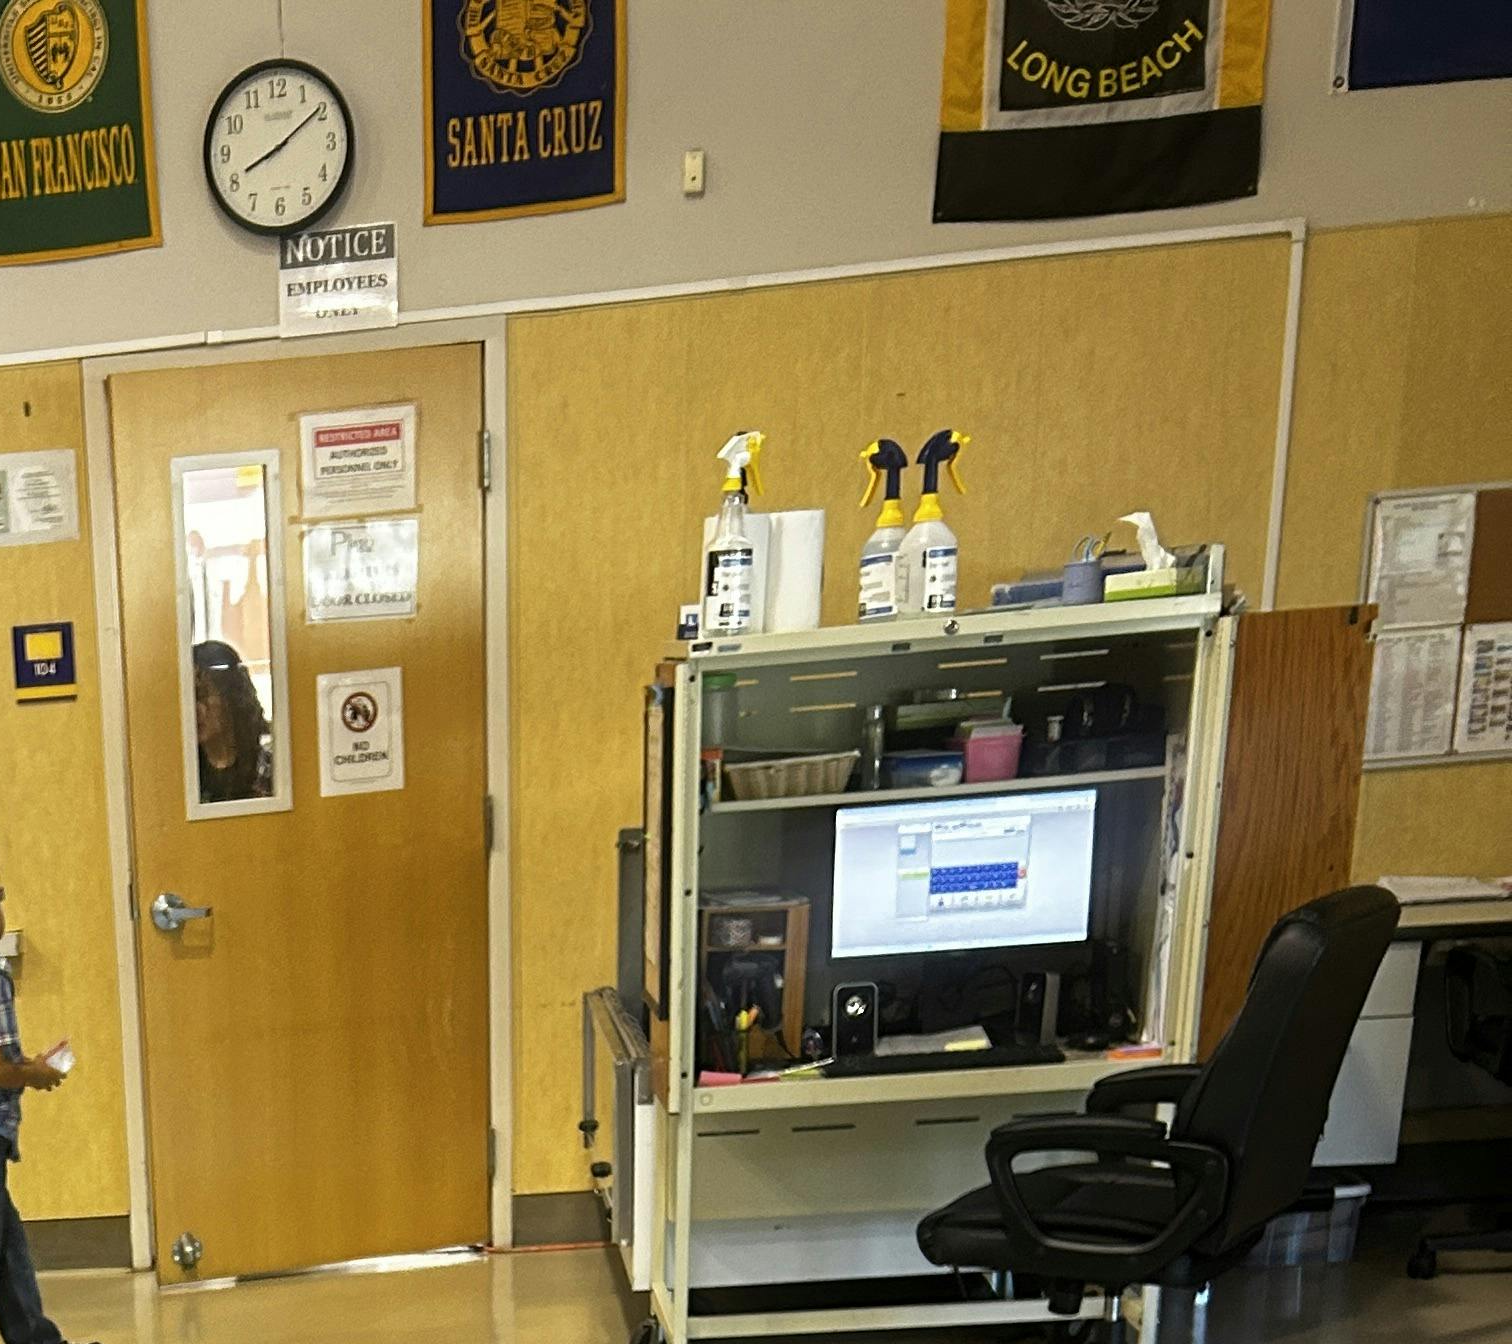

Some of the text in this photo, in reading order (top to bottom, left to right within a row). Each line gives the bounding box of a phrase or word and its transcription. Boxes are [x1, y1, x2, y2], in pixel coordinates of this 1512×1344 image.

[1006, 19, 1204, 99] LONG BEACH
[268, 78, 287, 99] 12
[299, 85, 306, 104] 1
[245, 89, 260, 110] 11
[317, 101, 327, 121] 2
[225, 114, 243, 135] 10
[448, 99, 604, 168] SANTA CRUZ
[326, 131, 336, 151] 3
[29, 122, 137, 197] FRANCISCO
[220, 144, 231, 164] 9
[318, 162, 327, 182] 4
[229, 173, 240, 193] 8
[248, 192, 258, 212] 7
[301, 186, 312, 206] 5
[274, 197, 286, 217] 6
[285, 228, 387, 265] NOTICE
[286, 272, 388, 297] EMPLOYEES
[333, 751, 389, 766] CHILDREN
